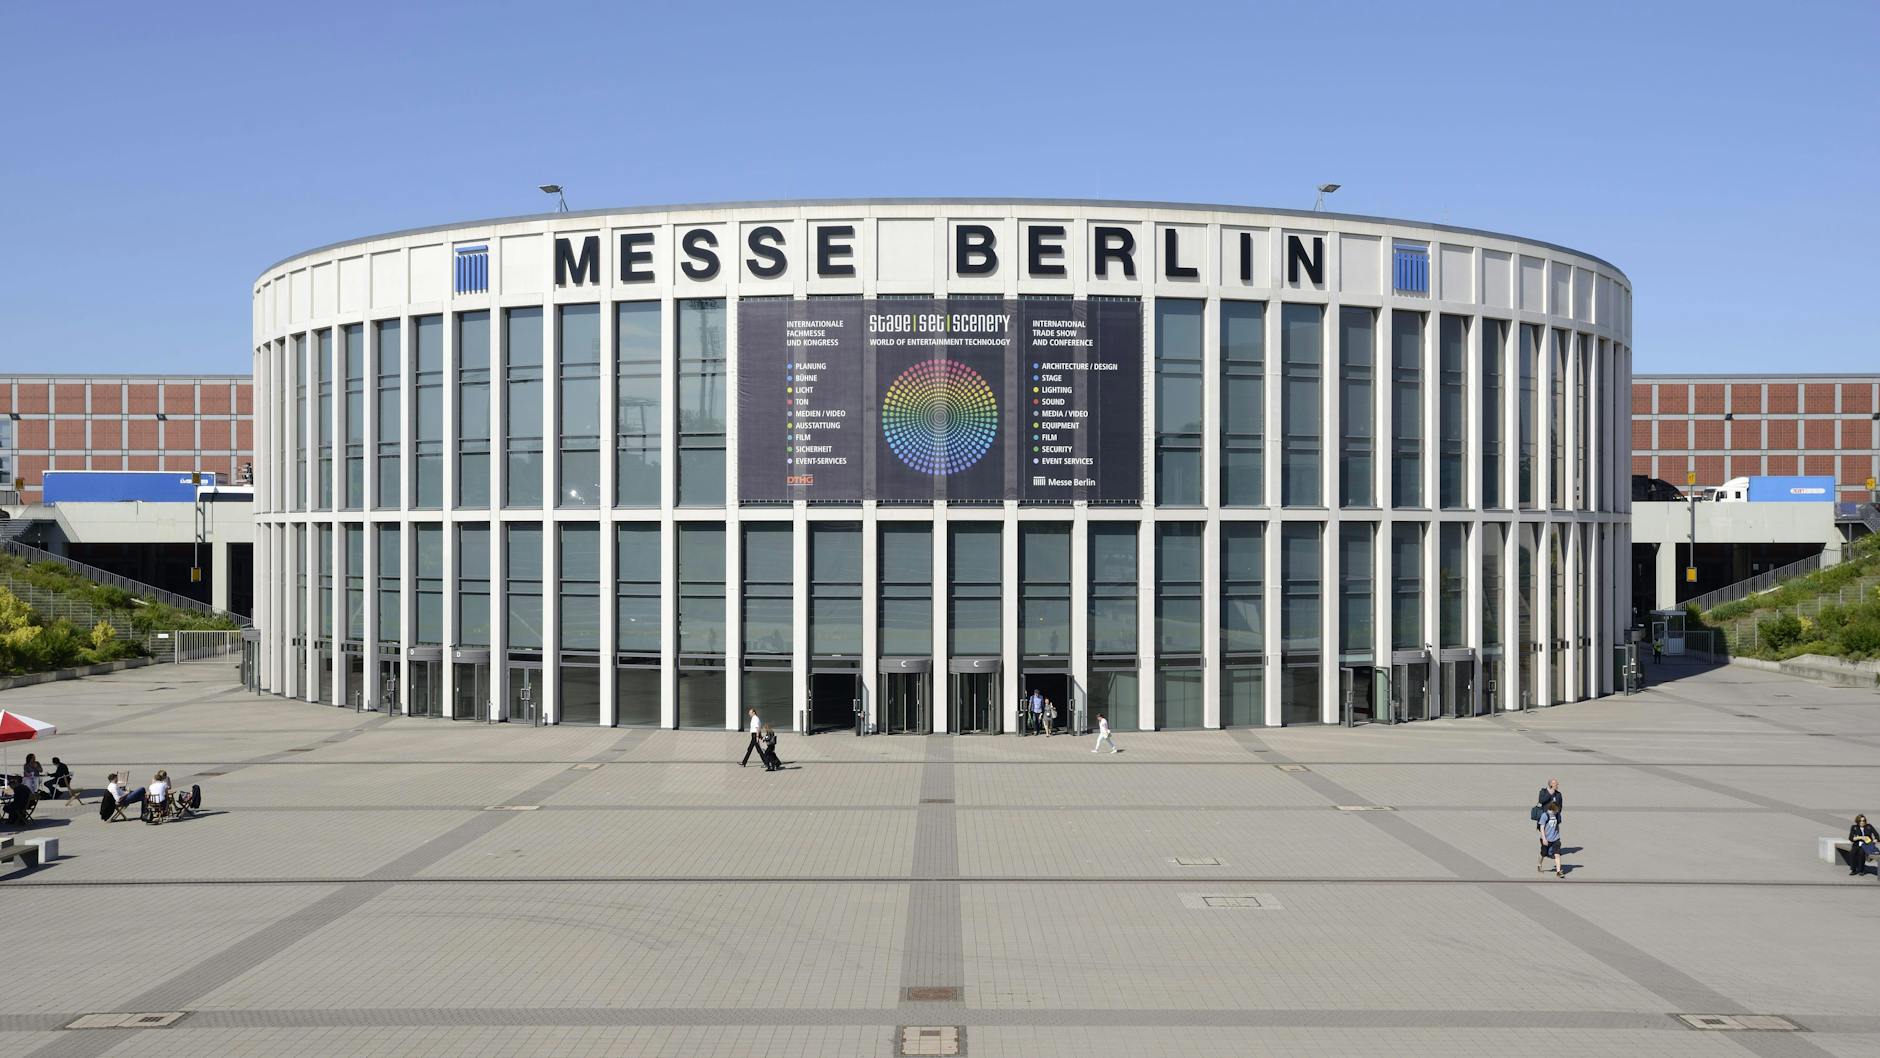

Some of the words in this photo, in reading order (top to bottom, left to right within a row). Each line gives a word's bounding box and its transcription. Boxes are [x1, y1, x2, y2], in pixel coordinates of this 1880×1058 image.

[555, 225, 855, 285] MESSE
[956, 224, 1325, 285] BERLIN
[786, 320, 844, 328] INTERNATIONALE
[1032, 320, 1086, 328] INTERNATIONAL
[786, 329, 826, 337] FACHMESSE
[1032, 329, 1055, 337] TRADE
[1056, 329, 1077, 337] SHOW
[803, 338, 839, 346] KONGRESS
[869, 338, 895, 346] WORLD
[896, 338, 905, 346] OF
[907, 338, 963, 346] ENTERTAINMENT
[964, 338, 1010, 346] TECHNOLOGY
[1032, 338, 1048, 346] AND
[1049, 339, 1094, 347] CONFERENCE
[795, 362, 827, 370] PLANUNG
[1041, 362, 1089, 370] ARCHITECTURE
[795, 373, 818, 382] BÜHNE
[1041, 374, 1062, 382] STAGE
[795, 386, 814, 394] LICHT
[1041, 386, 1073, 394] LIGHTING
[795, 398, 809, 406] TON
[1041, 398, 1066, 406] SOUND
[1041, 422, 1080, 430] EQUIPMENT
[795, 433, 811, 441] FILM
[1041, 433, 1058, 441] FILM
[795, 445, 832, 453] SICHERHEIT
[1041, 445, 1073, 453] SECURITY
[795, 457, 847, 465] EVENT-SERVICES
[1041, 457, 1062, 465] EVENT
[1063, 457, 1094, 465] SERVICES
[787, 475, 814, 485] DTHG
[1048, 478, 1073, 486] Messe
[1073, 478, 1096, 486] Berlin
